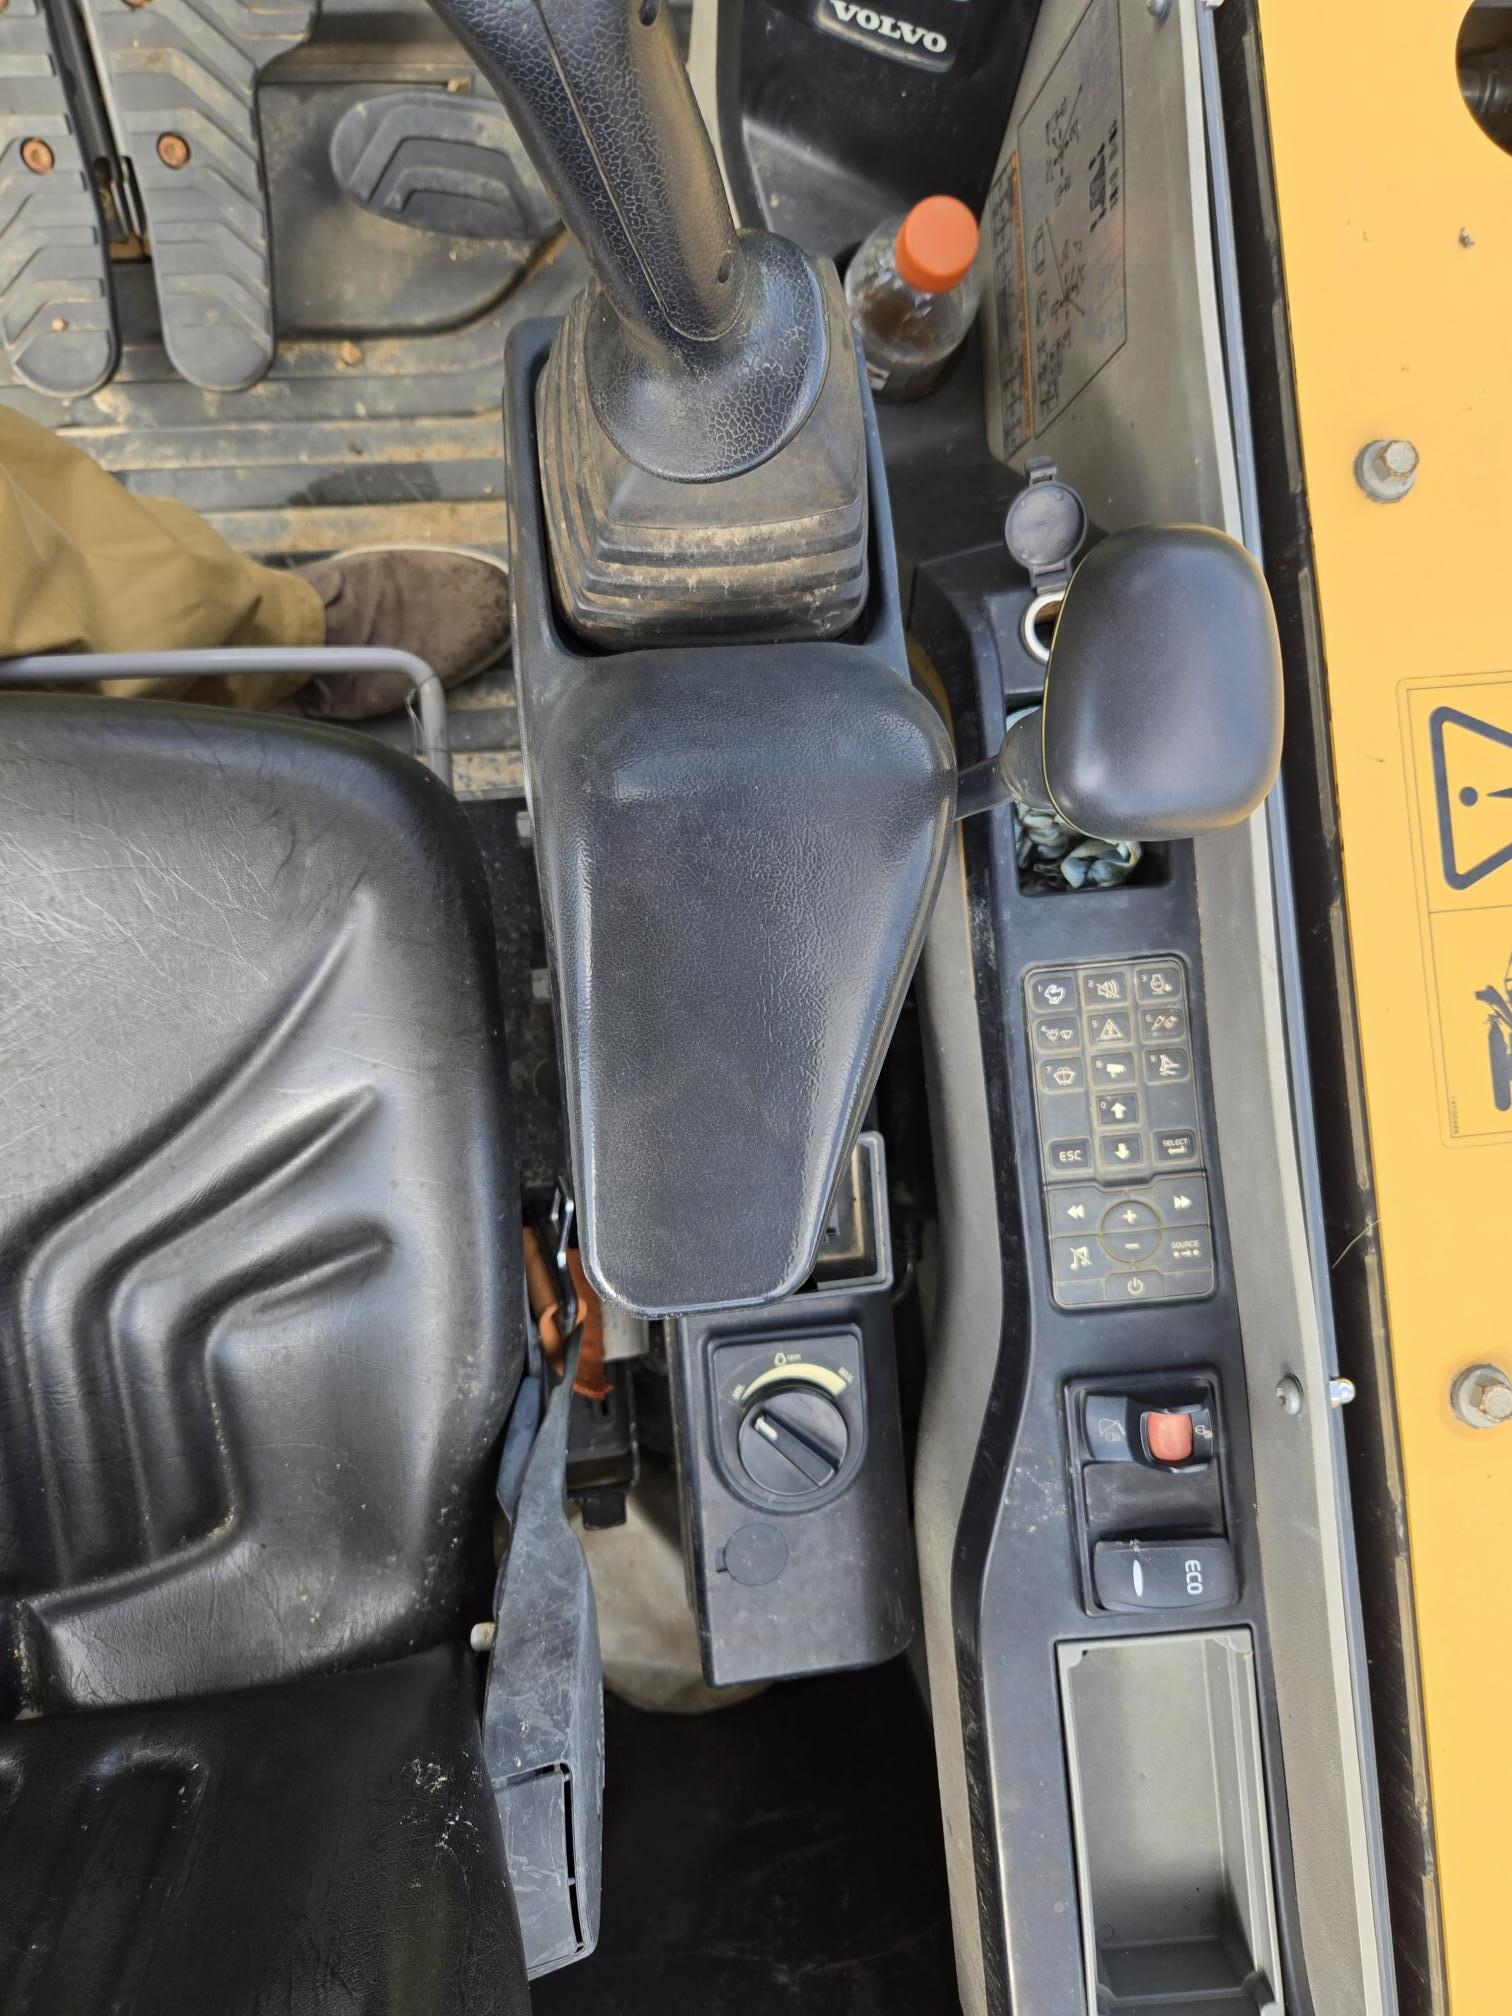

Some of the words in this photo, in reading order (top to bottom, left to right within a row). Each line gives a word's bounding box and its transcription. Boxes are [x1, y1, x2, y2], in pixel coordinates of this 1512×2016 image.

[829, 0, 947, 53] VOLVO
[1161, 1138, 1188, 1147] SELECT
[1059, 1150, 1082, 1162] ESC
[1171, 1240, 1200, 1249] SOURCE
[838, 1366, 854, 1384] MAX
[1185, 1559, 1203, 1595] ECO
